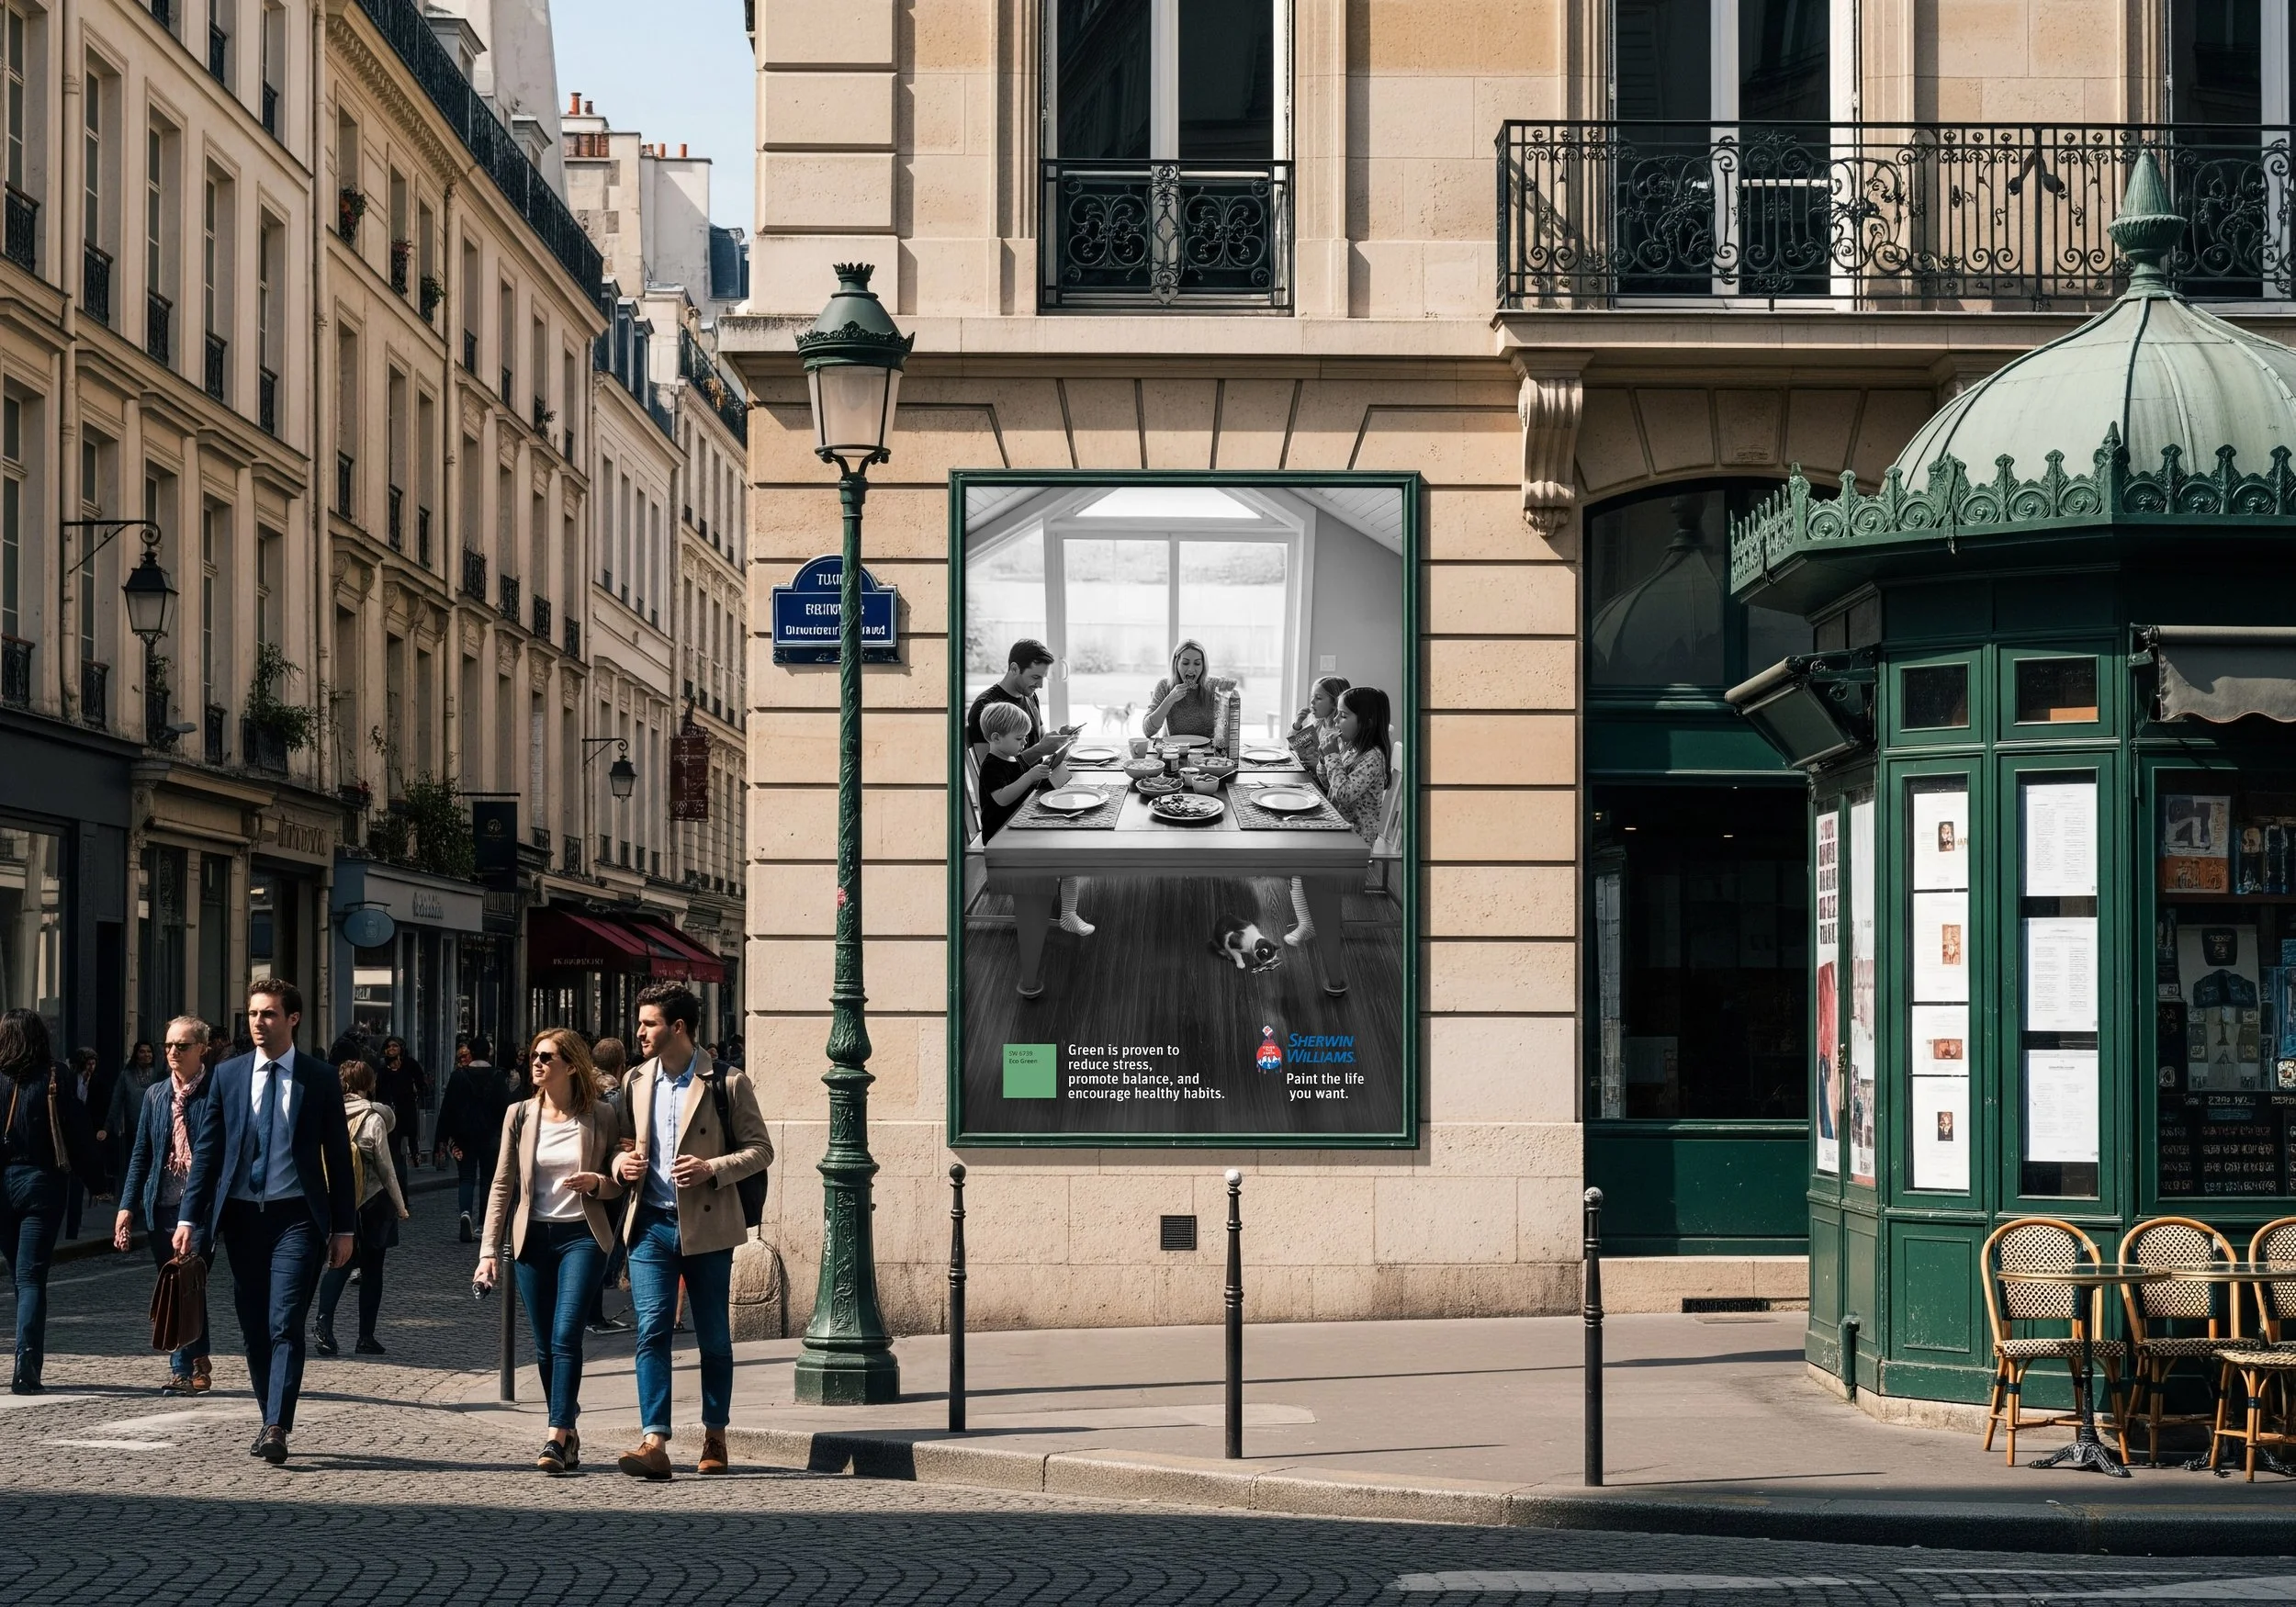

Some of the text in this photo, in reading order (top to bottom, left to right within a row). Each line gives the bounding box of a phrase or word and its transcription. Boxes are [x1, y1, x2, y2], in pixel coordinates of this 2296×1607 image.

[1289, 1033, 1355, 1048] SHERWIN
[1068, 1043, 1180, 1059] Green is proven to
[1068, 1058, 1153, 1073] reduce stress,
[1068, 1073, 1199, 1087] promote balance, and
[1287, 1073, 1365, 1084] Paint the life
[1067, 1087, 1225, 1102] encourage healthy habits.
[1289, 1088, 1349, 1102] you want.
